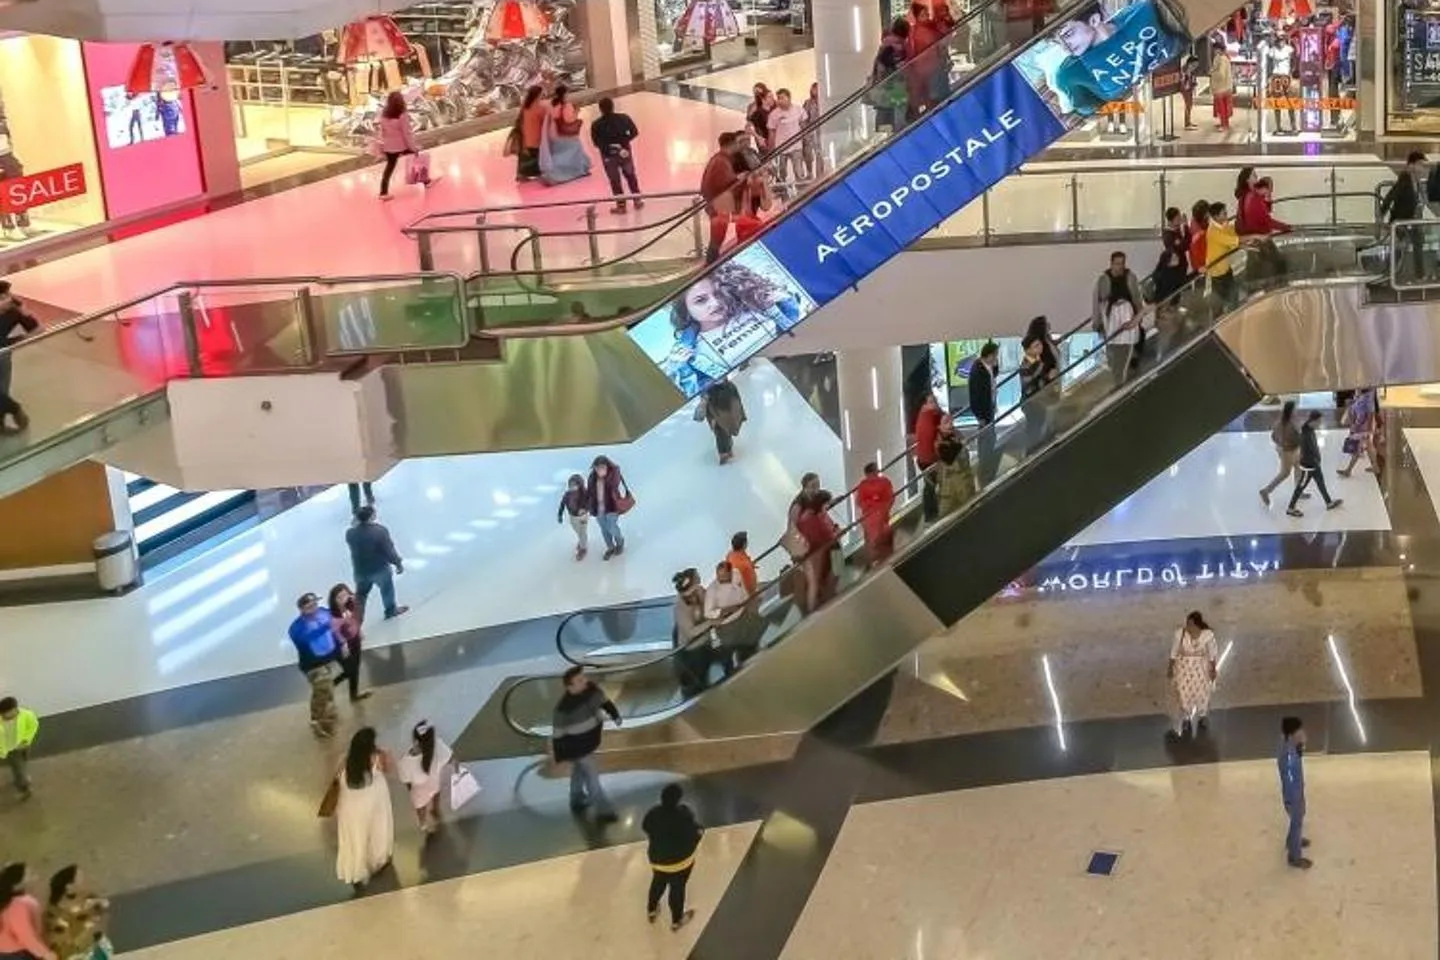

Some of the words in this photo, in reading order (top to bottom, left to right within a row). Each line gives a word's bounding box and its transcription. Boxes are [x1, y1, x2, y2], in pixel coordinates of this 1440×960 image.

[1092, 26, 1157, 82] AERO
[9, 170, 81, 206] SALE
[815, 108, 1022, 264] AÉROPOSTALE
